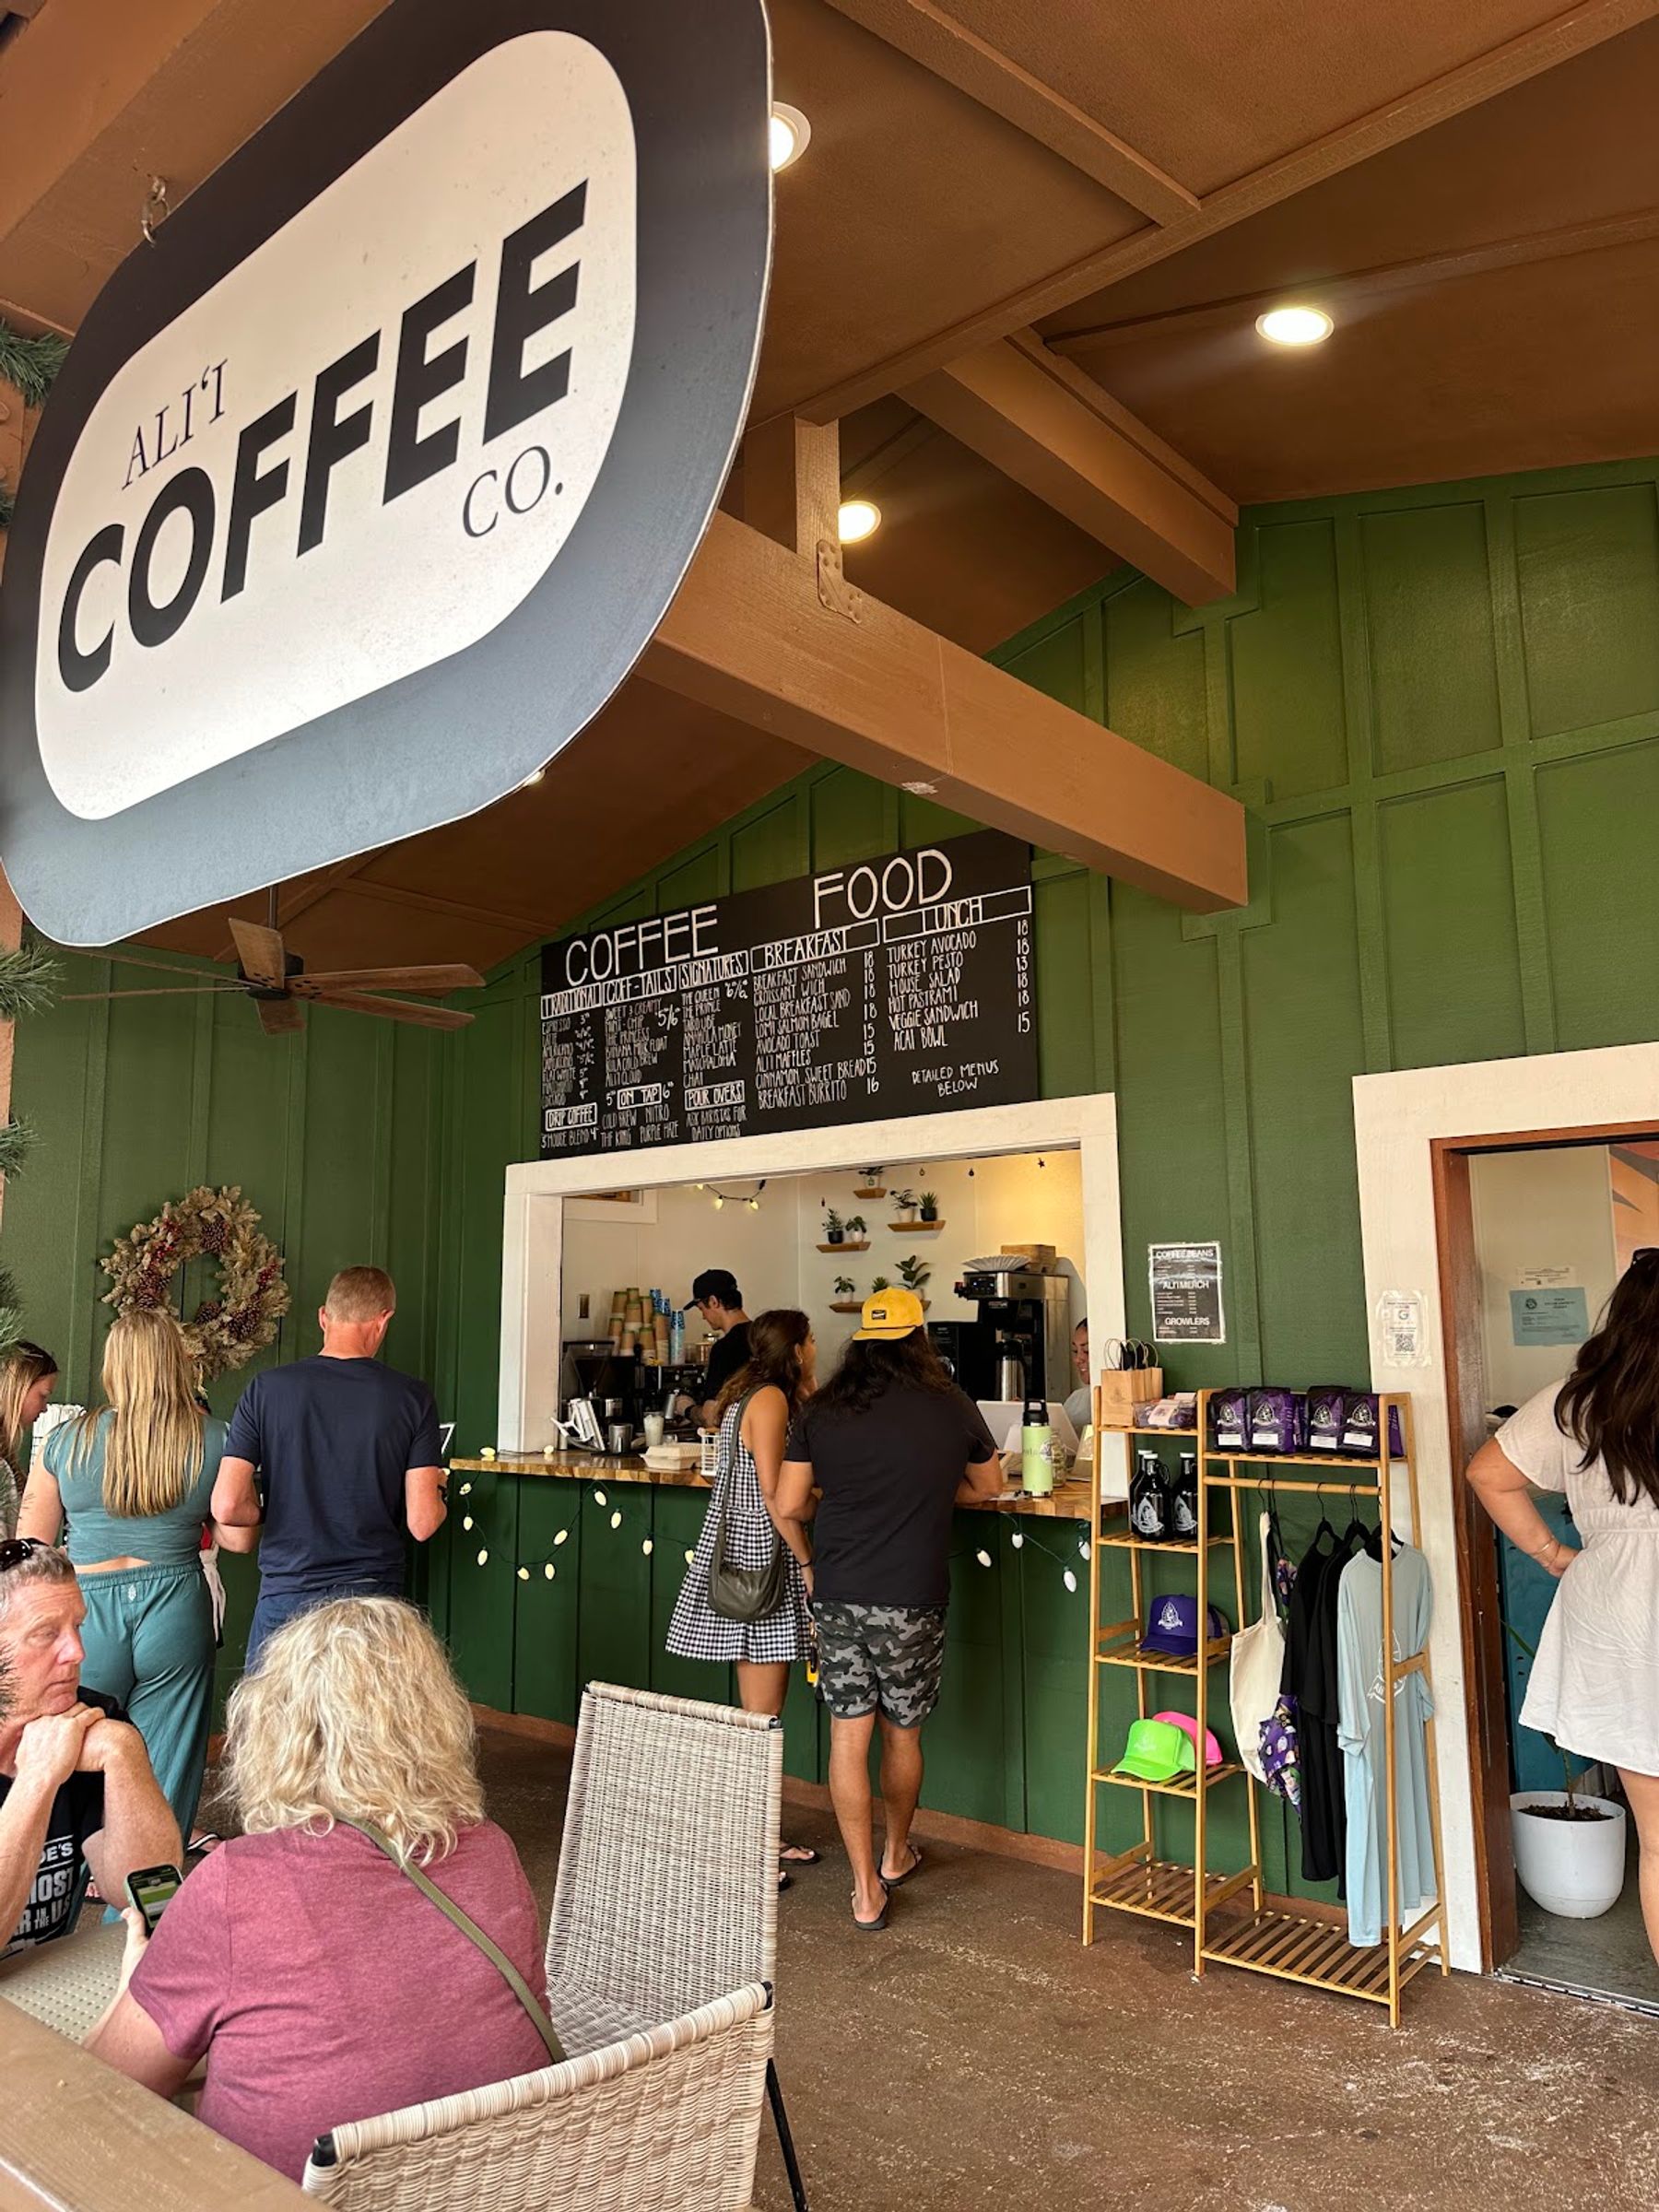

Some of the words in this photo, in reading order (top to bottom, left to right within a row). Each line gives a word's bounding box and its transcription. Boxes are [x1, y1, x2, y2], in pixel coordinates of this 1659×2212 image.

[58, 177, 589, 693] COFFEE
[461, 443, 564, 539] CO.
[813, 848, 953, 930] FOOD
[922, 897, 983, 933] LUNCH
[565, 904, 719, 987] COFFEE
[764, 928, 847, 968] BREAKFAST
[887, 940, 927, 964] TURKEY
[930, 930, 977, 955] AVOCADO
[1017, 919, 1029, 936] 18
[681, 951, 744, 987] SIGNATURES
[753, 968, 798, 992] BREAKFAST
[801, 958, 847, 981] SANDWICH
[864, 950, 875, 969] 18
[887, 958, 927, 981] TURKEY
[932, 950, 964, 971] PESTO
[1017, 937, 1030, 956] 18
[753, 985, 795, 1006] CROISSANT
[801, 978, 825, 998] WICH
[864, 968, 875, 983] 18
[889, 974, 922, 997] HOUSE
[928, 967, 961, 990] SALAD
[1016, 956, 1029, 972] 13
[546, 983, 600, 1018] TRADITIONAL
[681, 992, 693, 1006] THE
[694, 987, 721, 1004] QUEEN
[754, 1004, 779, 1023] LOCAL
[779, 993, 829, 1017] BREAKFAST
[829, 988, 852, 1011] SAND
[865, 983, 876, 1000] 18
[888, 994, 908, 1015] HOT
[908, 984, 959, 1010] PASTRAMI
[1017, 972, 1029, 990] 18
[634, 998, 662, 1016] CREAMY
[682, 1005, 694, 1018] THE
[694, 999, 722, 1018] PRINCE
[888, 1008, 922, 1032] VEGGIE
[923, 999, 979, 1026] SANDWICH
[1018, 989, 1030, 1006] 18
[700, 1013, 716, 1030] UBE
[754, 1019, 774, 1040] LOMI
[777, 1015, 810, 1036] SALMON
[810, 1010, 840, 1030] BAGEL
[865, 1002, 877, 1021] 18
[893, 1028, 916, 1052] ACAI
[921, 1025, 949, 1050] BOWL
[1017, 1011, 1030, 1033] 15
[605, 1030, 618, 1046] THE
[619, 1027, 650, 1044] PRINCESS
[649, 1035, 668, 1053] FLOAT
[756, 1035, 791, 1056] AVOCADO
[793, 1030, 820, 1050] TOAST
[864, 1023, 876, 1041] 15
[864, 1040, 875, 1056] 15
[639, 1051, 658, 1067] BREW
[683, 1043, 712, 1060] MAPLE
[712, 1039, 737, 1056] LATTE
[683, 1072, 703, 1088] CHAI
[756, 1068, 800, 1089] CINNAMON
[805, 1064, 833, 1084] SWEET
[838, 1058, 866, 1079] BREAD
[866, 1057, 877, 1075] 15
[912, 1065, 953, 1085] DETAILED
[959, 1059, 1000, 1078] MENUS
[620, 1089, 635, 1106] ON
[641, 1087, 658, 1104] TAP
[688, 1088, 710, 1107] POUR
[712, 1083, 743, 1103] OVERS
[758, 1084, 806, 1110] BREAKFAST
[808, 1079, 847, 1106] BURRITO
[866, 1077, 879, 1095] 16
[937, 1077, 979, 1098] BELOW
[547, 1110, 566, 1128] DRIP
[567, 1106, 593, 1125] COFFEE
[602, 1112, 618, 1129] COLD
[618, 1109, 637, 1127] BREW
[645, 1103, 670, 1124] NITRO
[686, 1112, 700, 1127] ASK
[733, 1105, 747, 1123] FOR
[569, 1127, 590, 1146] BLEND
[600, 1131, 614, 1147] THE
[640, 1124, 662, 1143] PURPLE
[663, 1120, 679, 1139] HAZE
[691, 1125, 714, 1141] DAILY
[714, 1124, 741, 1139] OPTIONS
[1164, 1317, 1210, 1326] GROWLERS
